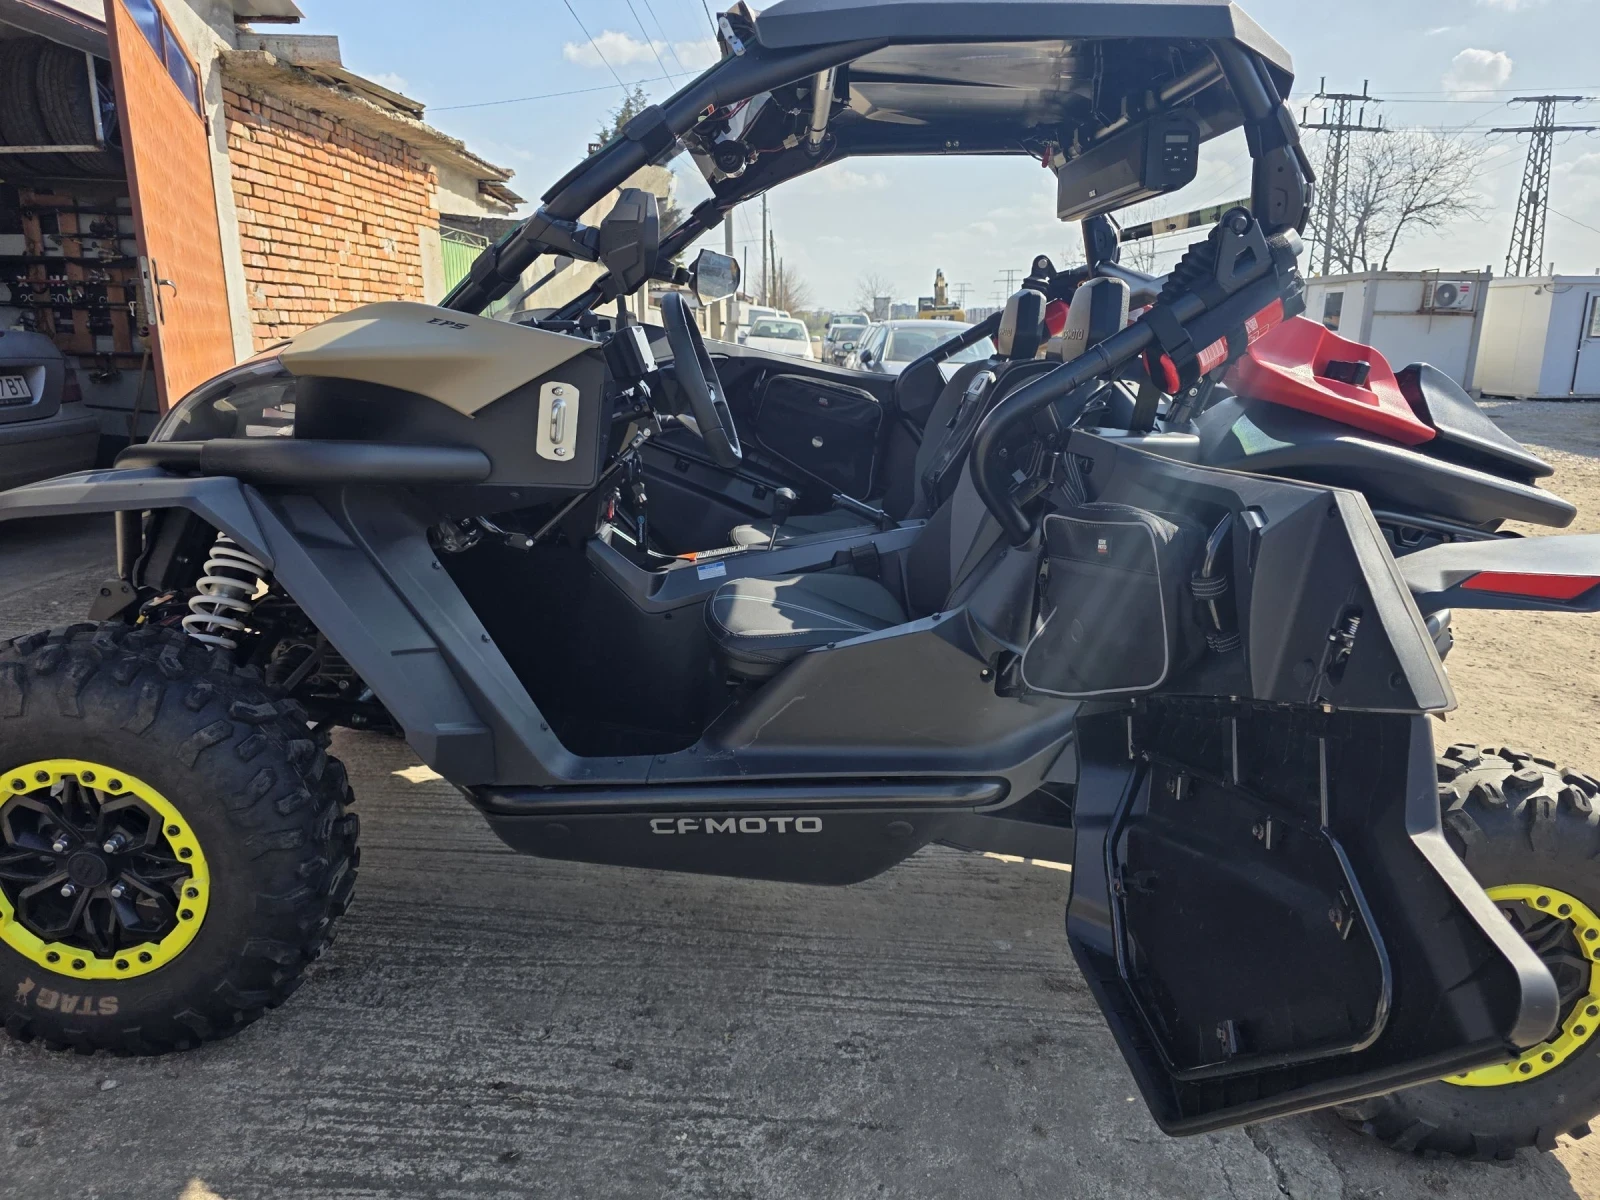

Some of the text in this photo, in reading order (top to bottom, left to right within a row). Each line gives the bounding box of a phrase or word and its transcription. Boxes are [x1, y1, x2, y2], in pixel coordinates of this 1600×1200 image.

[426, 318, 470, 330] EPS
[650, 817, 823, 834] CFMOTO
[36, 987, 119, 1015] STAG
